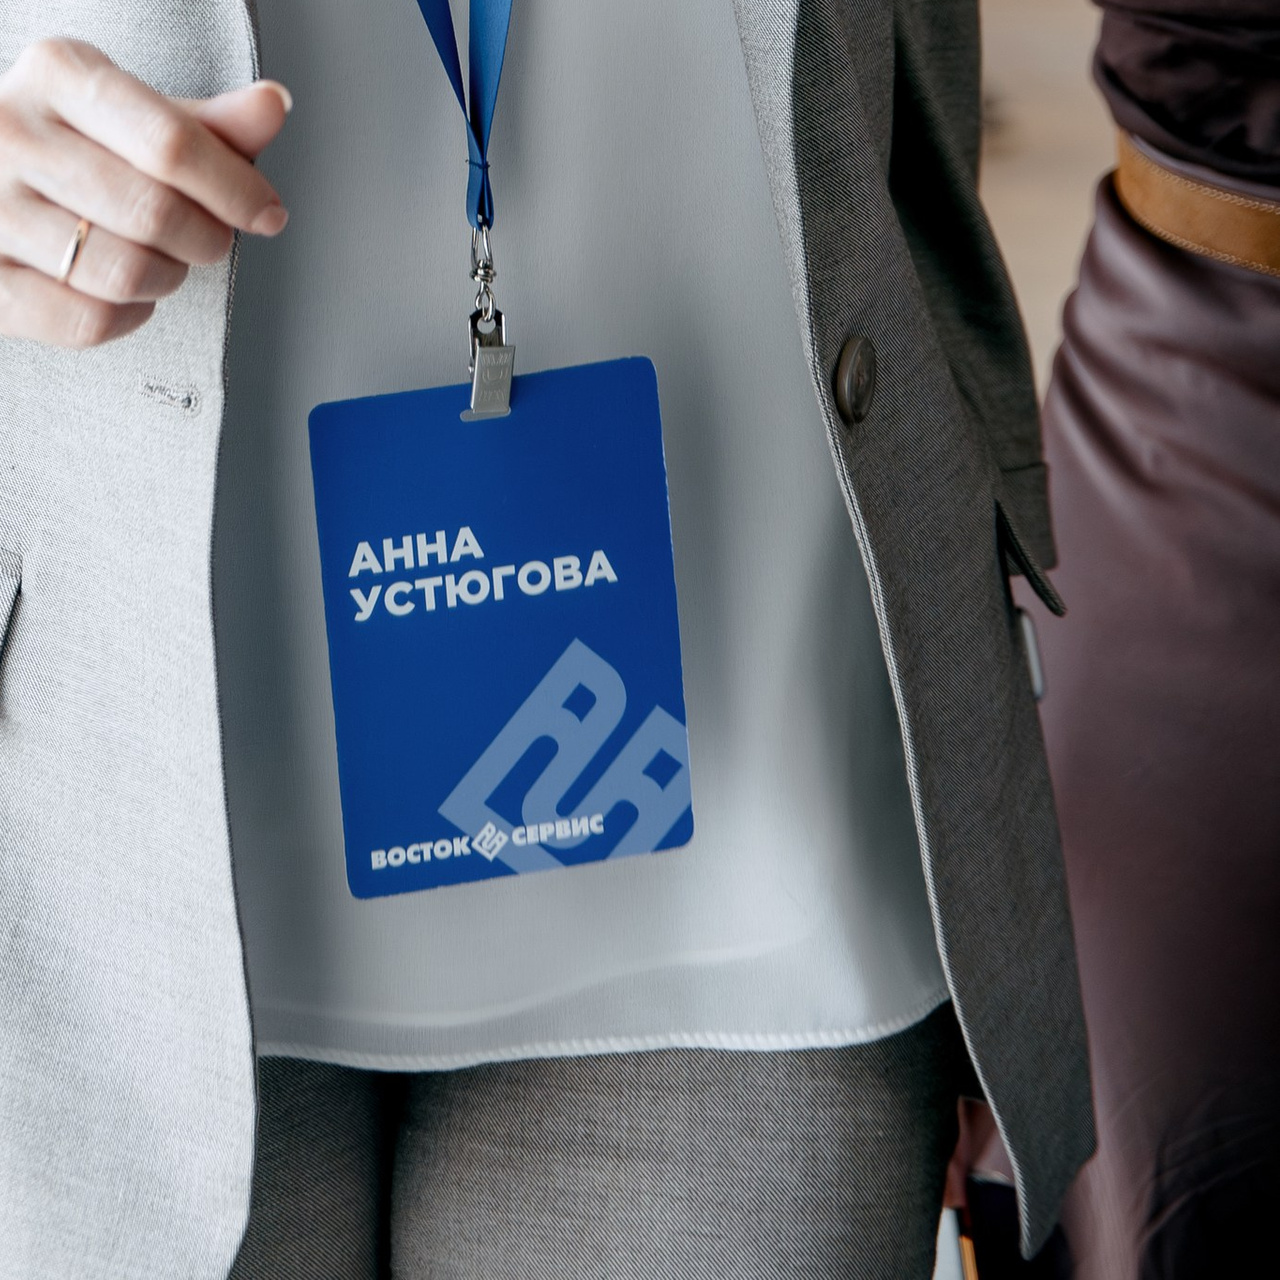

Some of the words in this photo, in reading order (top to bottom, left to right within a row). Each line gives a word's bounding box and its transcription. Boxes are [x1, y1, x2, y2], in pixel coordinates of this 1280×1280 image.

[348, 526, 485, 578] АННА
[349, 549, 619, 622] УСТЮГОВА
[371, 836, 471, 870] ВОСТОК
[511, 813, 604, 845] СЕРВИС
